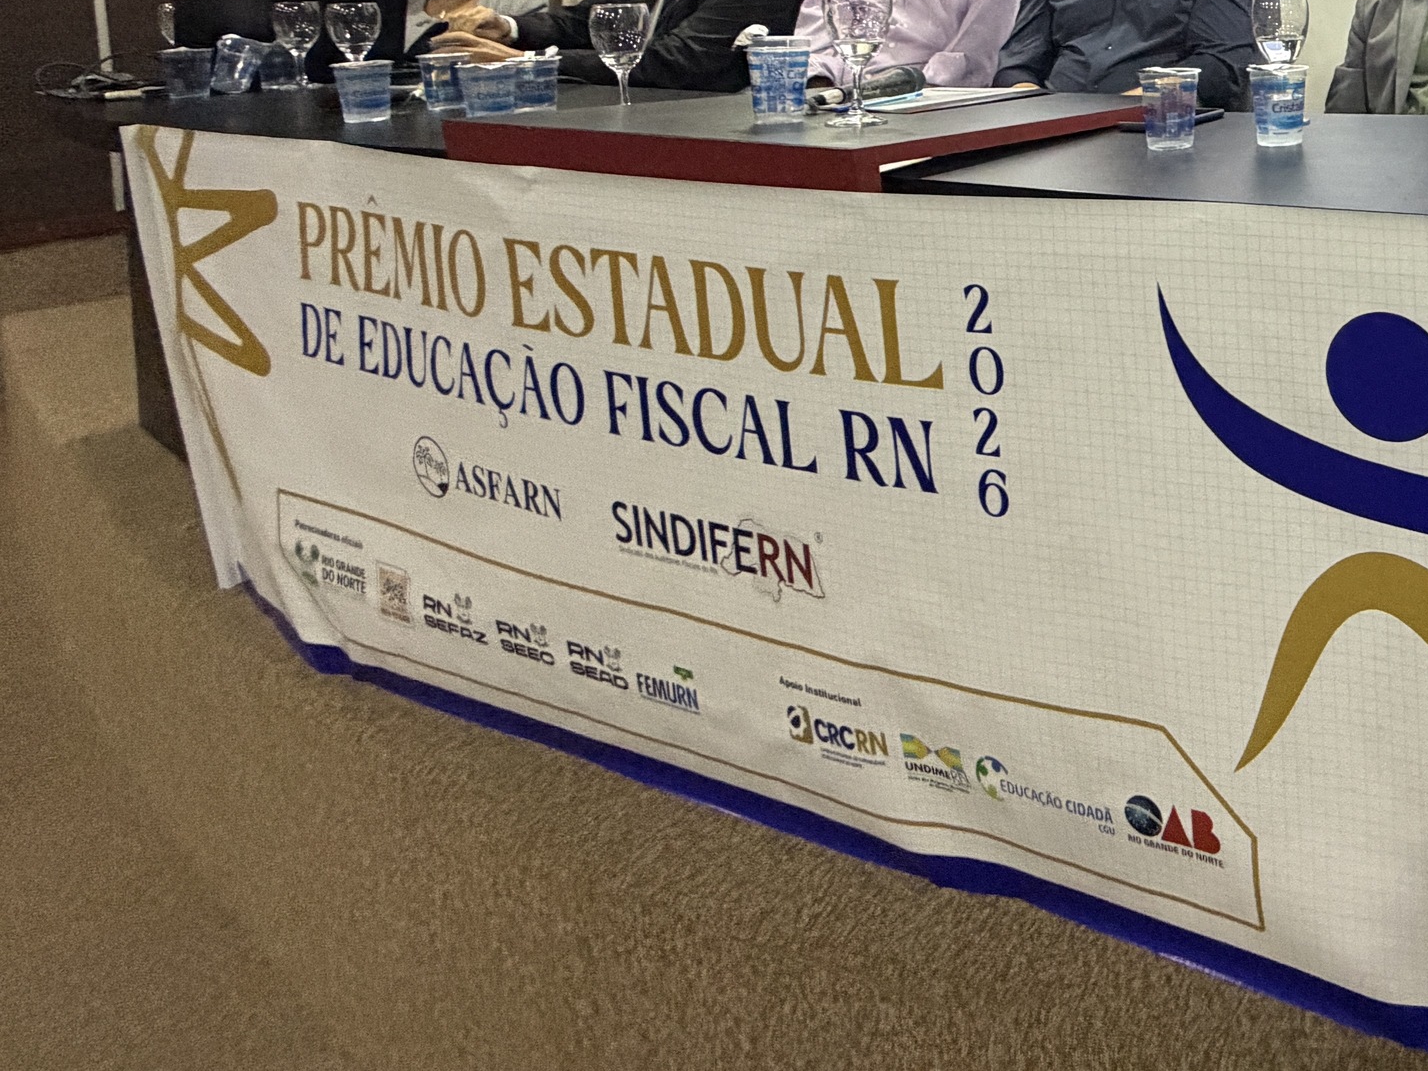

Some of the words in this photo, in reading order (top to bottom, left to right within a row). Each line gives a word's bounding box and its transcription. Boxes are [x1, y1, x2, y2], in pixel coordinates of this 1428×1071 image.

[297, 194, 486, 318] PRÊMIO
[503, 237, 944, 390] ESTADUAL
[300, 302, 345, 366] DE
[358, 315, 585, 429] EDUCAÇÃO
[603, 369, 818, 474] FISCAL
[838, 409, 939, 494] RN
[963, 283, 1010, 517] 2026
[455, 461, 562, 521] ASFARN
[612, 501, 814, 590] SINDIFERN
[321, 567, 335, 583] DO
[336, 572, 367, 594] NORTE
[423, 594, 452, 618] RN
[423, 614, 489, 645] SEFAZ
[495, 619, 531, 643] RN
[566, 640, 604, 665] RN
[570, 661, 629, 690] SEAD
[636, 672, 700, 710] FEMURN
[779, 675, 803, 692] Apoio
[805, 684, 862, 707] Institucional
[814, 718, 889, 757] CRCRN
[1000, 778, 1063, 809] EDUCAÇÃO
[1065, 799, 1114, 824] CIDADÃ
[1098, 823, 1116, 836] CGU
[1127, 833, 1142, 846] RIO
[1143, 837, 1179, 854] GRANDE
[1181, 847, 1194, 859] DO
[1195, 851, 1224, 869] NORTE
